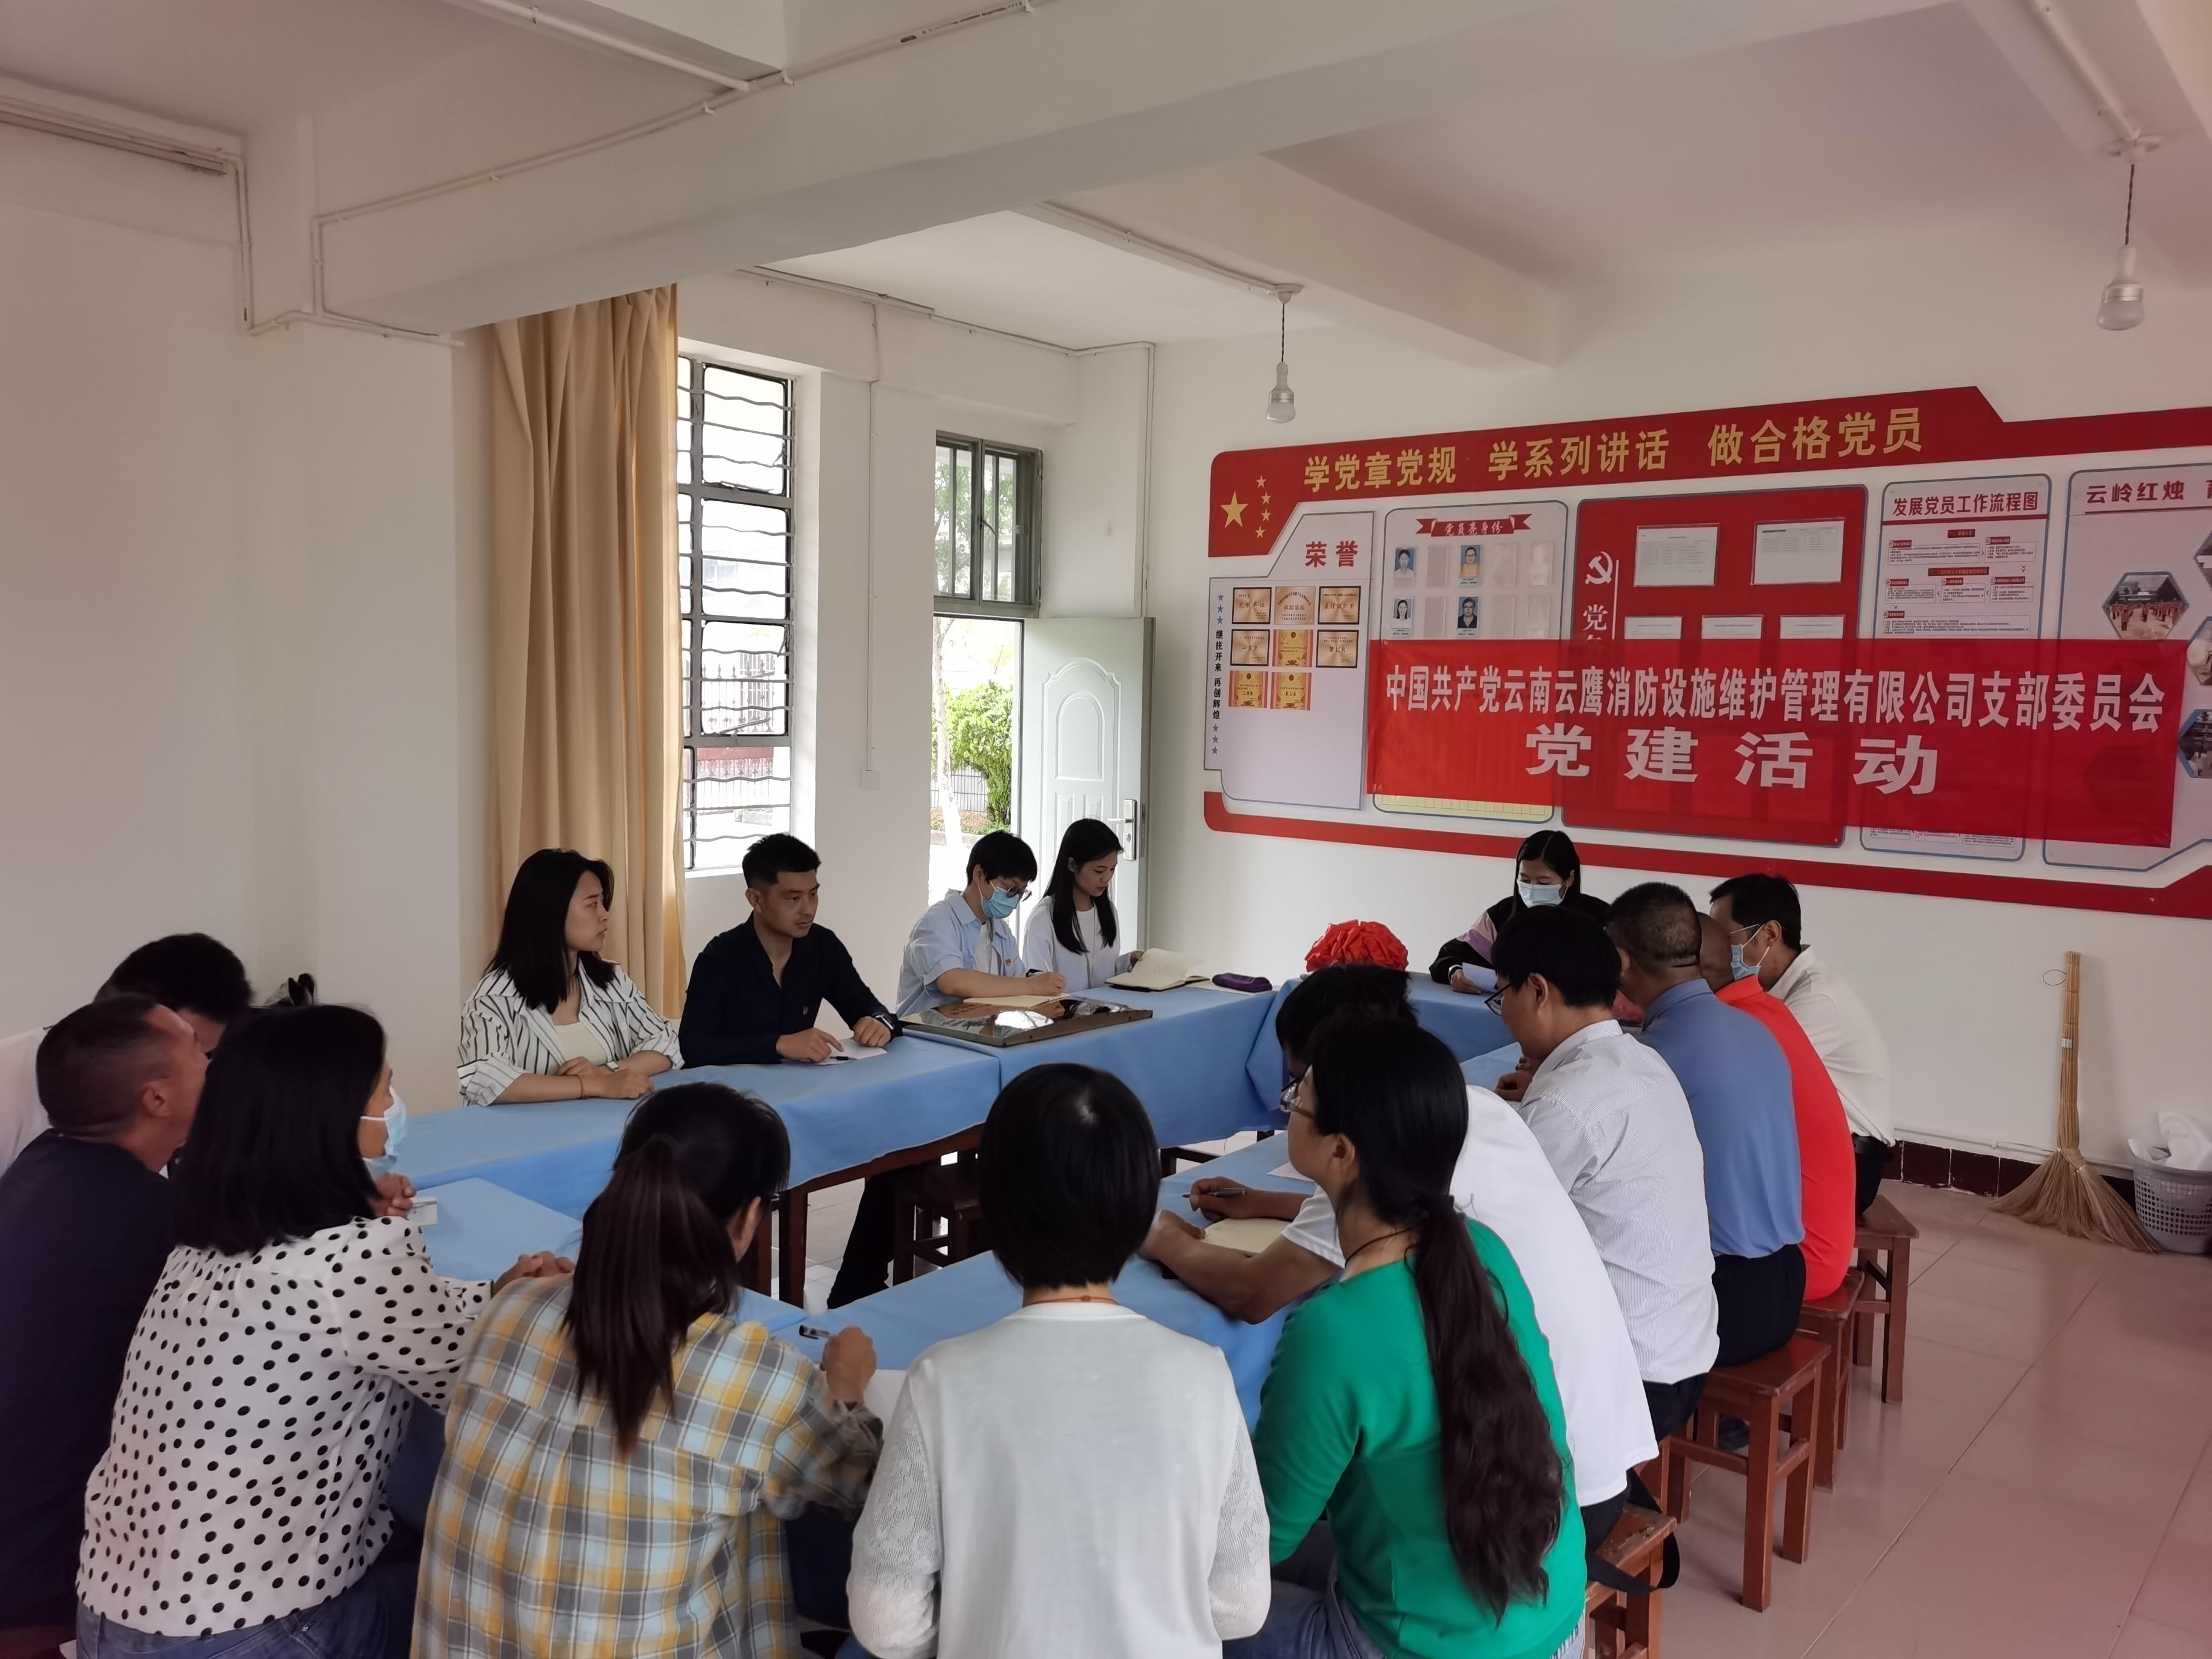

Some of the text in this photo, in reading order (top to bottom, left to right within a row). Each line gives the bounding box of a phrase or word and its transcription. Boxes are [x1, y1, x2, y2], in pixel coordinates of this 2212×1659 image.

[1304, 407, 1923, 493] 学党章党规 学系列讲话 做合格党员
[1892, 491, 2039, 516] 发展党员工作流程图
[2086, 480, 2185, 503] 云岭红烛
[1445, 521, 1504, 537] 党员亮身份
[1304, 540, 1359, 568] 荣誉
[1212, 629, 1224, 720] 继往开来 再创辉煌
[1386, 665, 2165, 733] 中国共产党云南云鹰消防设施维护管理有限公司支部委员会
[1526, 723, 1939, 796] 党建活动
